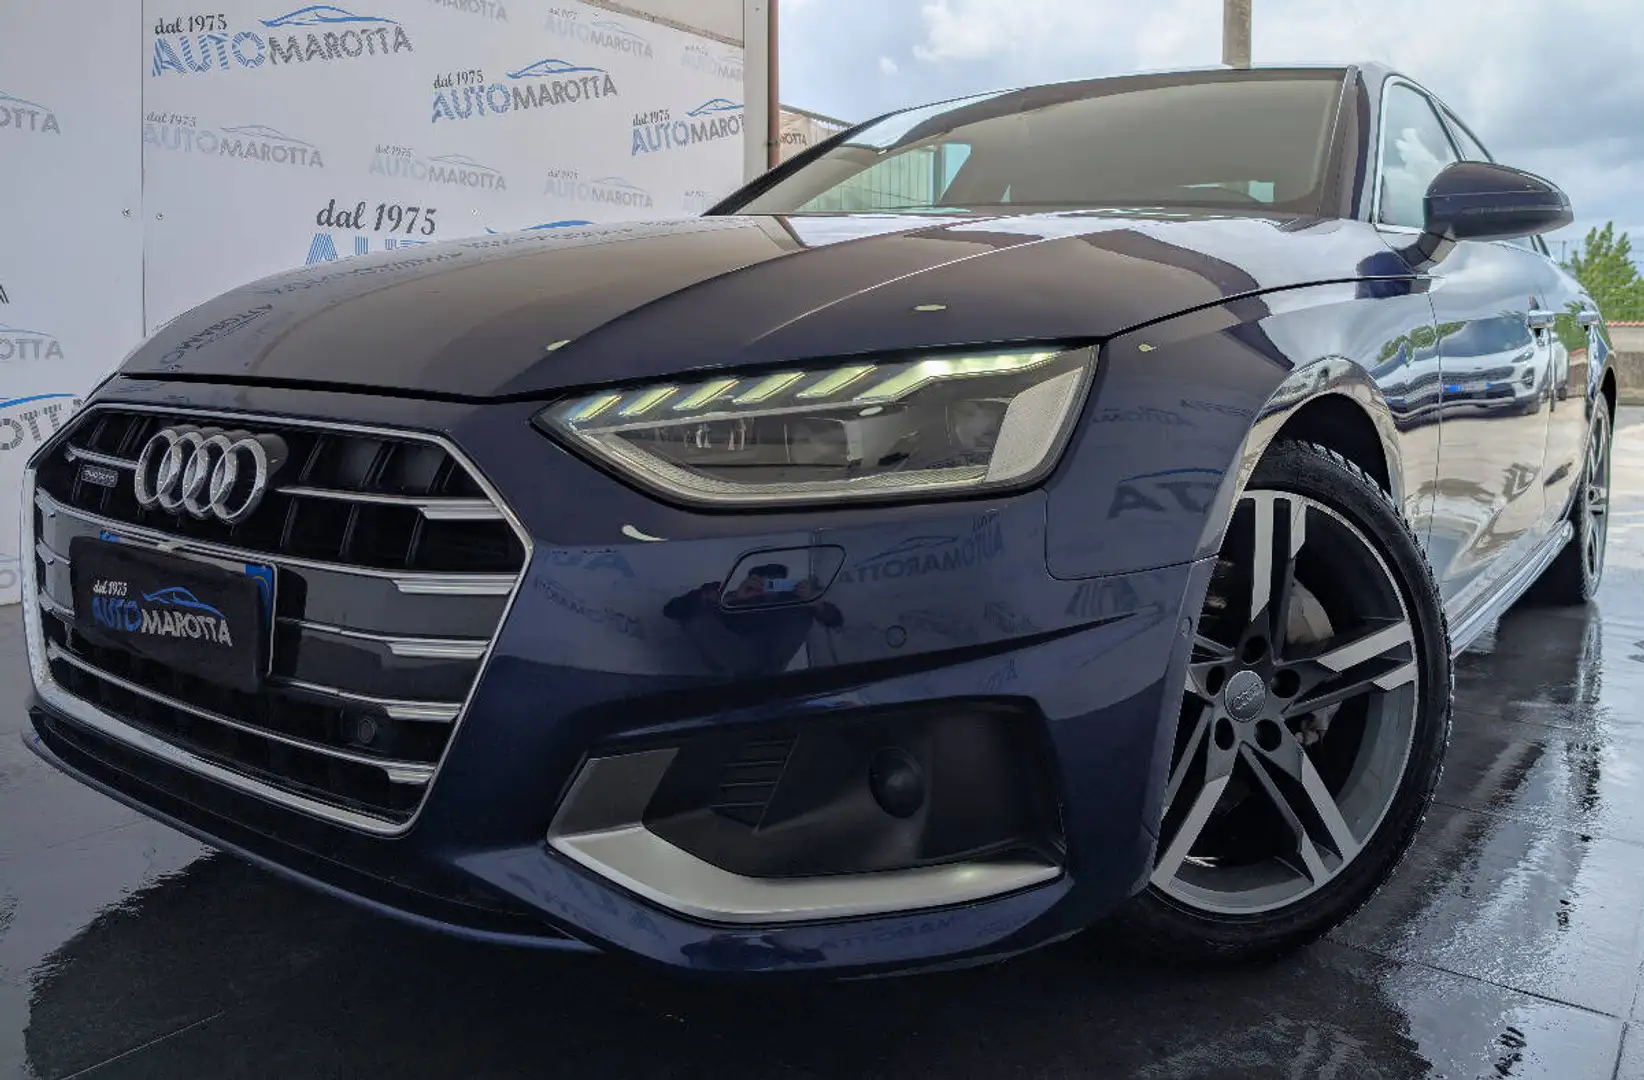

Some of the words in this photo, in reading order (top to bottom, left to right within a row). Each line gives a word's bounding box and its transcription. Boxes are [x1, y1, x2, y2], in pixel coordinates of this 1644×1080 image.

[154, 17, 183, 36] dal
[187, 14, 228, 33] 1975
[152, 26, 414, 77] AUTOMAROTTA
[433, 74, 453, 89] dal
[456, 70, 484, 86] 1975
[432, 74, 618, 123] AUTOMAROTTA
[649, 109, 670, 124] 1975
[143, 124, 324, 168] AUTOMAROTTA
[369, 154, 508, 191] AUTOMAROTTA
[543, 179, 653, 209] AUTOMAROTTA
[316, 198, 366, 230] dal
[373, 202, 437, 236] 1975
[92, 597, 234, 647] AUTOMAROTTA
